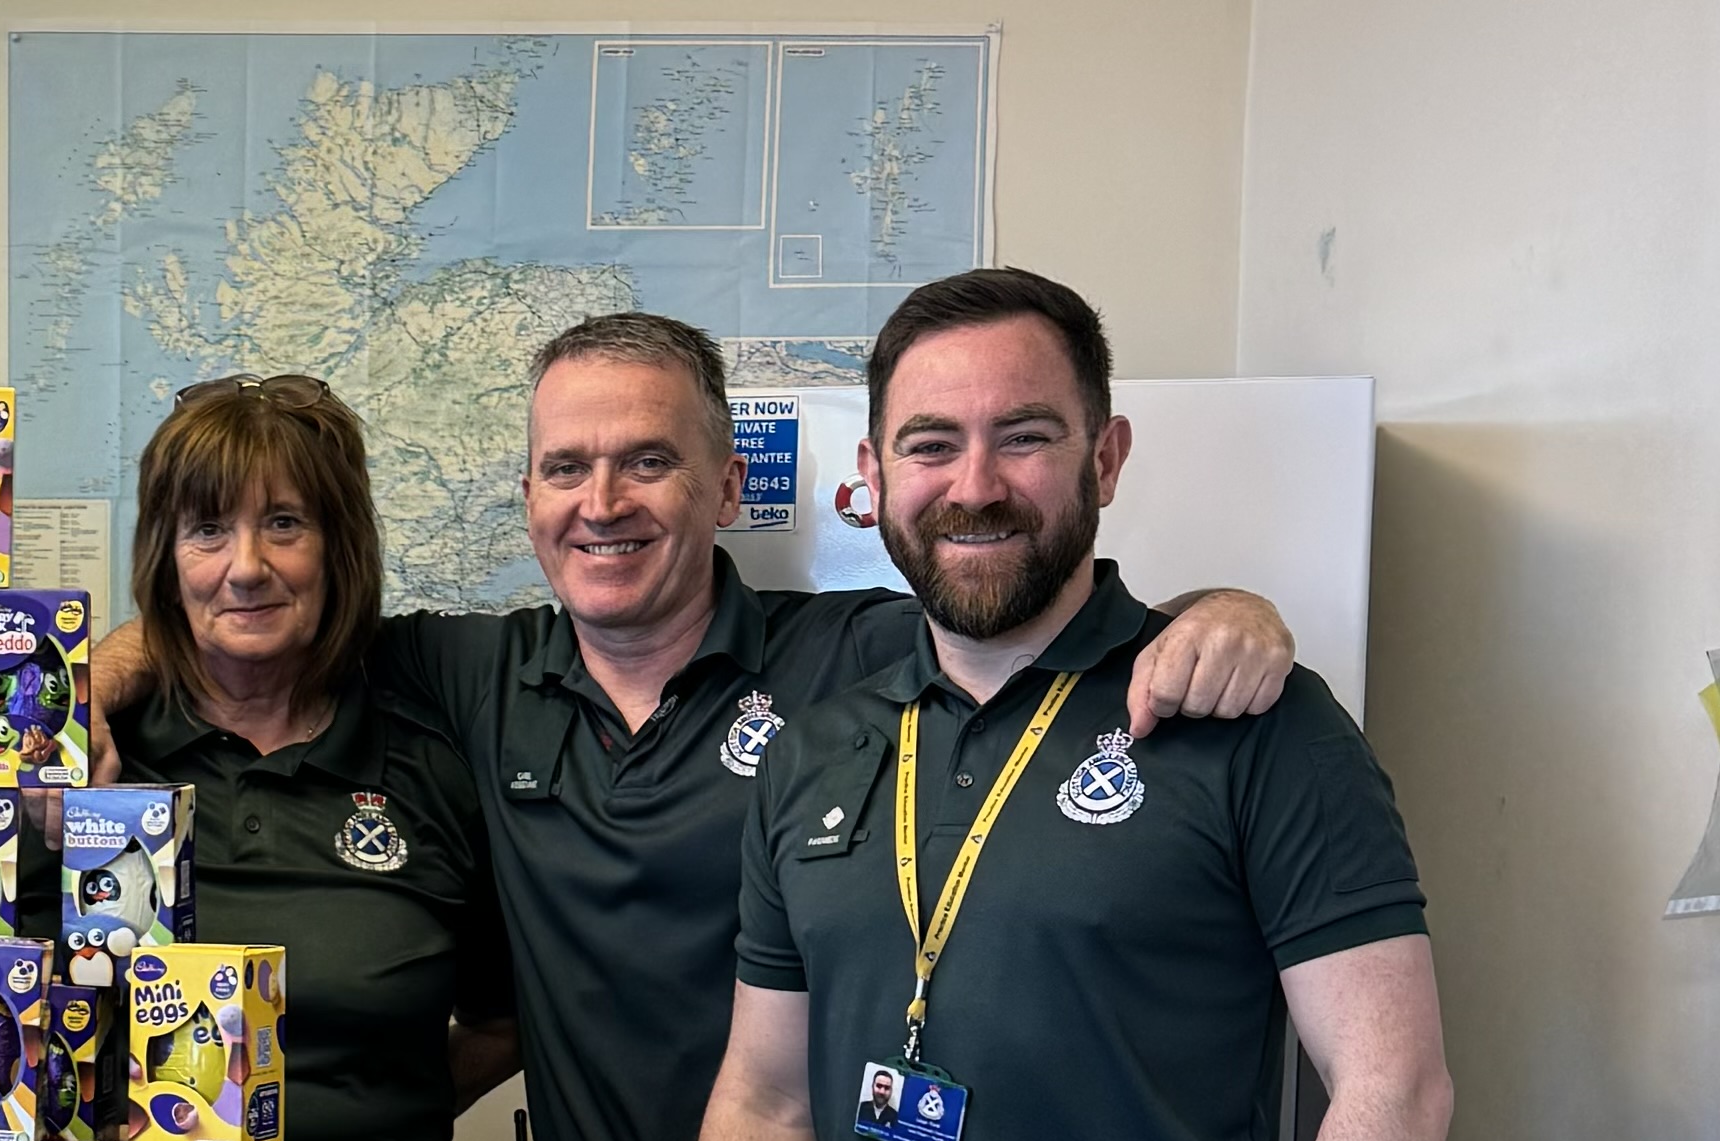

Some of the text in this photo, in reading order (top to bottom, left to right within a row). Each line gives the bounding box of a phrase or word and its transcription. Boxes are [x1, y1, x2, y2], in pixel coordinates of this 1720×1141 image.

[755, 402, 794, 415] NOW
[734, 438, 765, 449] FREE
[748, 477, 790, 491] 8643
[750, 507, 789, 520] beko
[66, 818, 126, 835] white
[65, 833, 127, 849] buttons
[134, 979, 183, 1007] Mini
[135, 1003, 189, 1026] eggs
